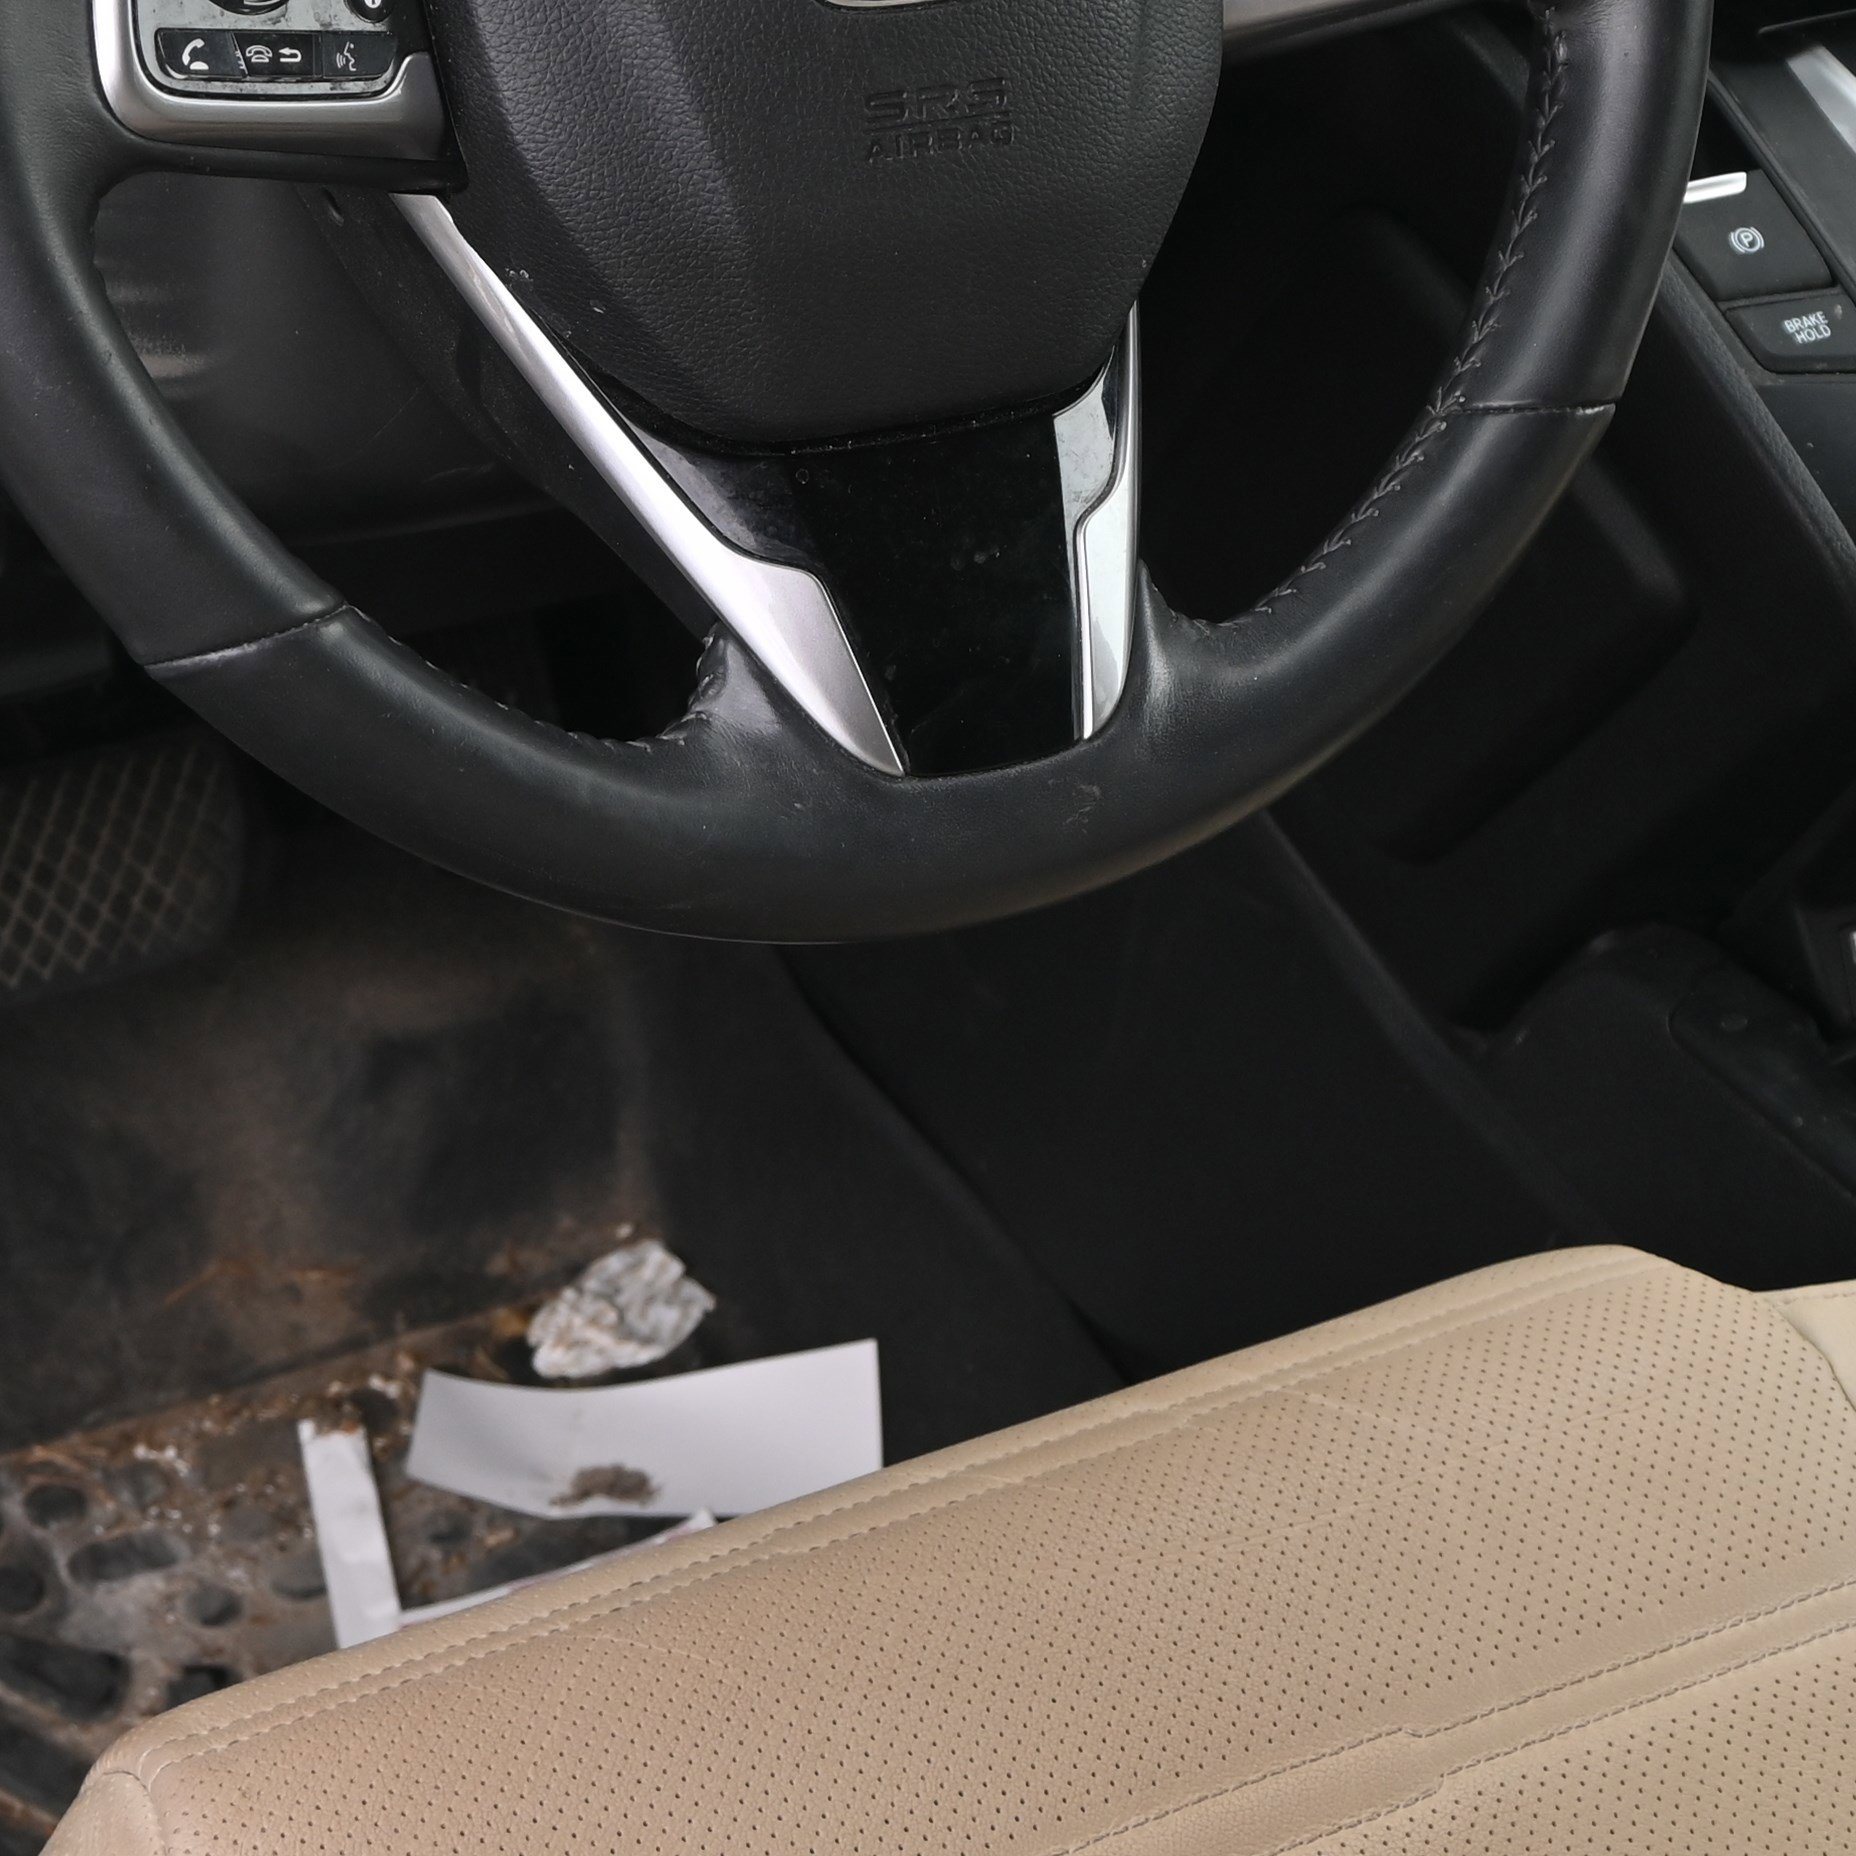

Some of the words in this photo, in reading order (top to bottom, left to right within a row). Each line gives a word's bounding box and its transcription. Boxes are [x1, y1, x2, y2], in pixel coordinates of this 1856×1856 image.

[865, 76, 1008, 124] SRS
[866, 119, 1015, 164] AIRBAG
[1783, 310, 1829, 334] BRAKE
[1794, 324, 1832, 344] HOLD
